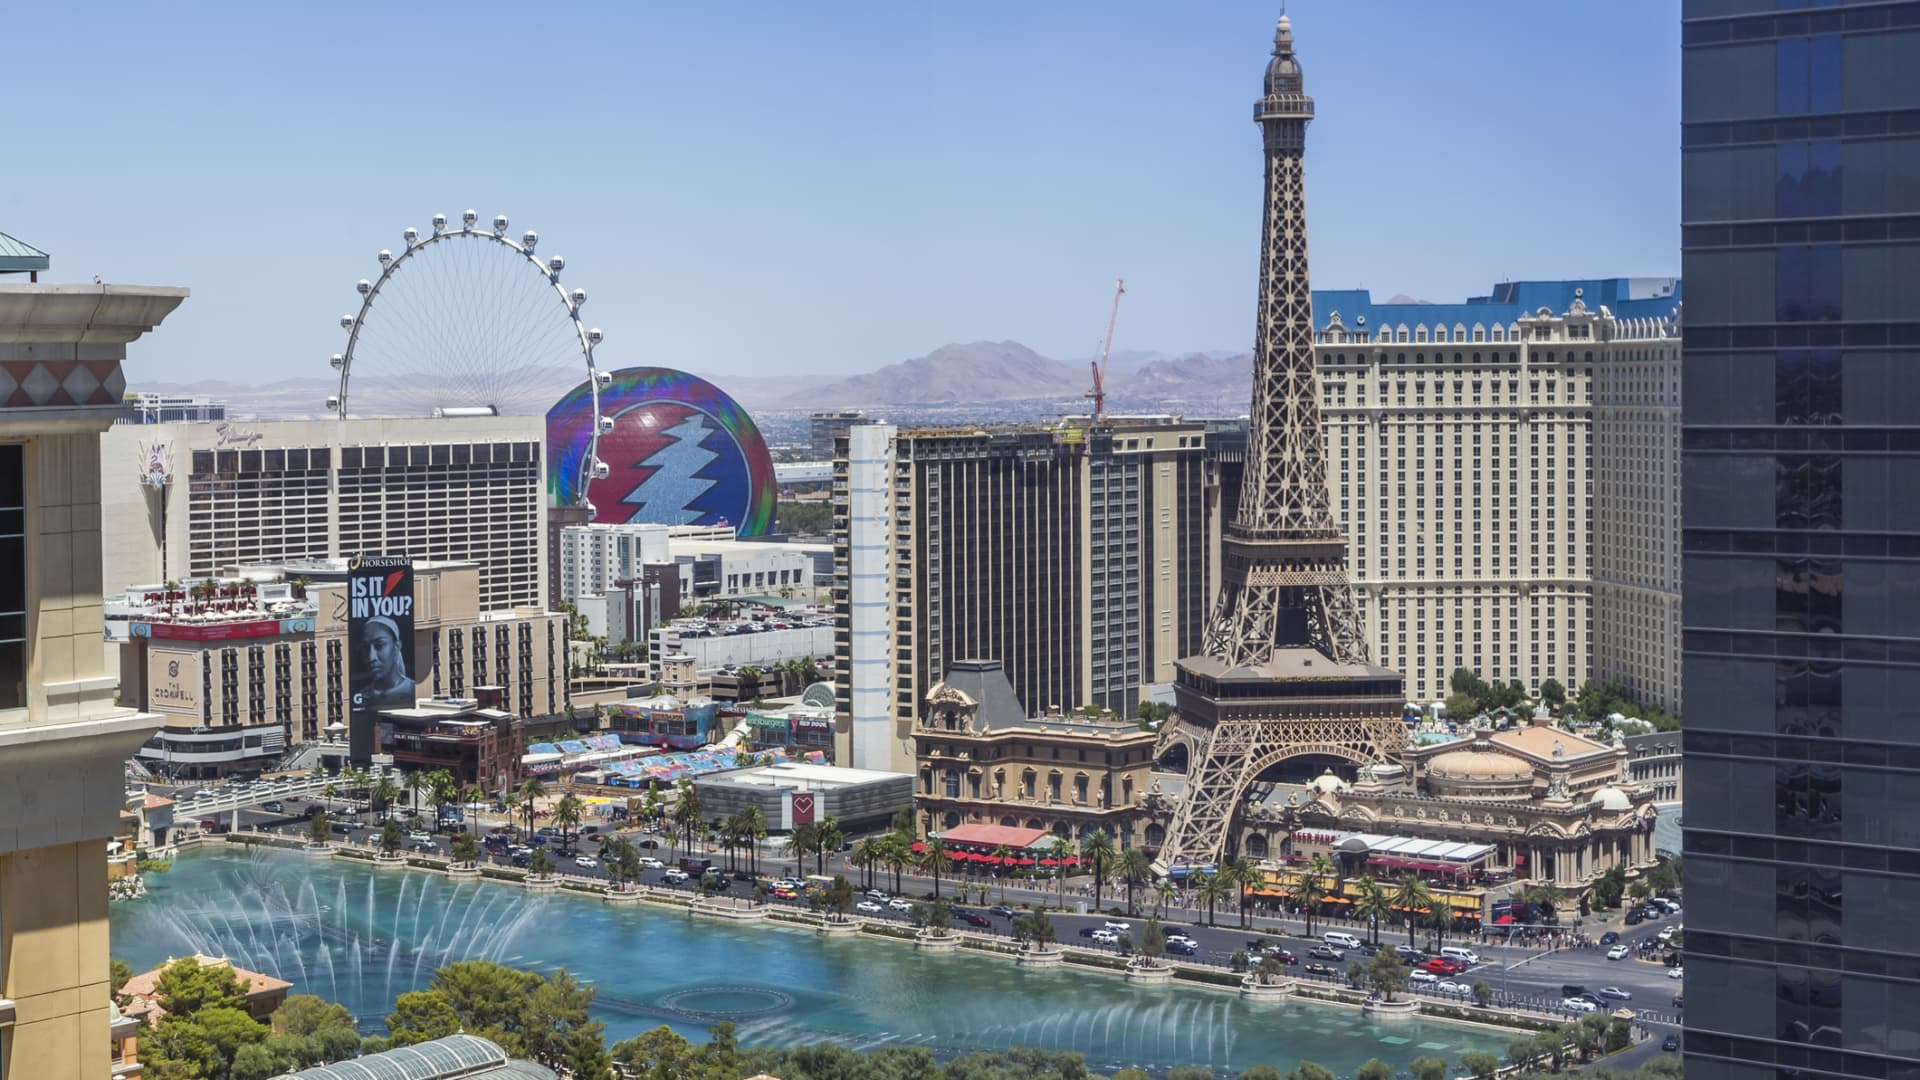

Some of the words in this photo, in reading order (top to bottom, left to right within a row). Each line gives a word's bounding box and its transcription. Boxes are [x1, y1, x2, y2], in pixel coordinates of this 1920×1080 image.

[361, 557, 411, 567] HORSESHOE
[352, 577, 367, 597] IS
[369, 576, 384, 596] IT
[352, 598, 369, 618] IN
[370, 595, 412, 616] YOU?
[353, 693, 363, 704] G
